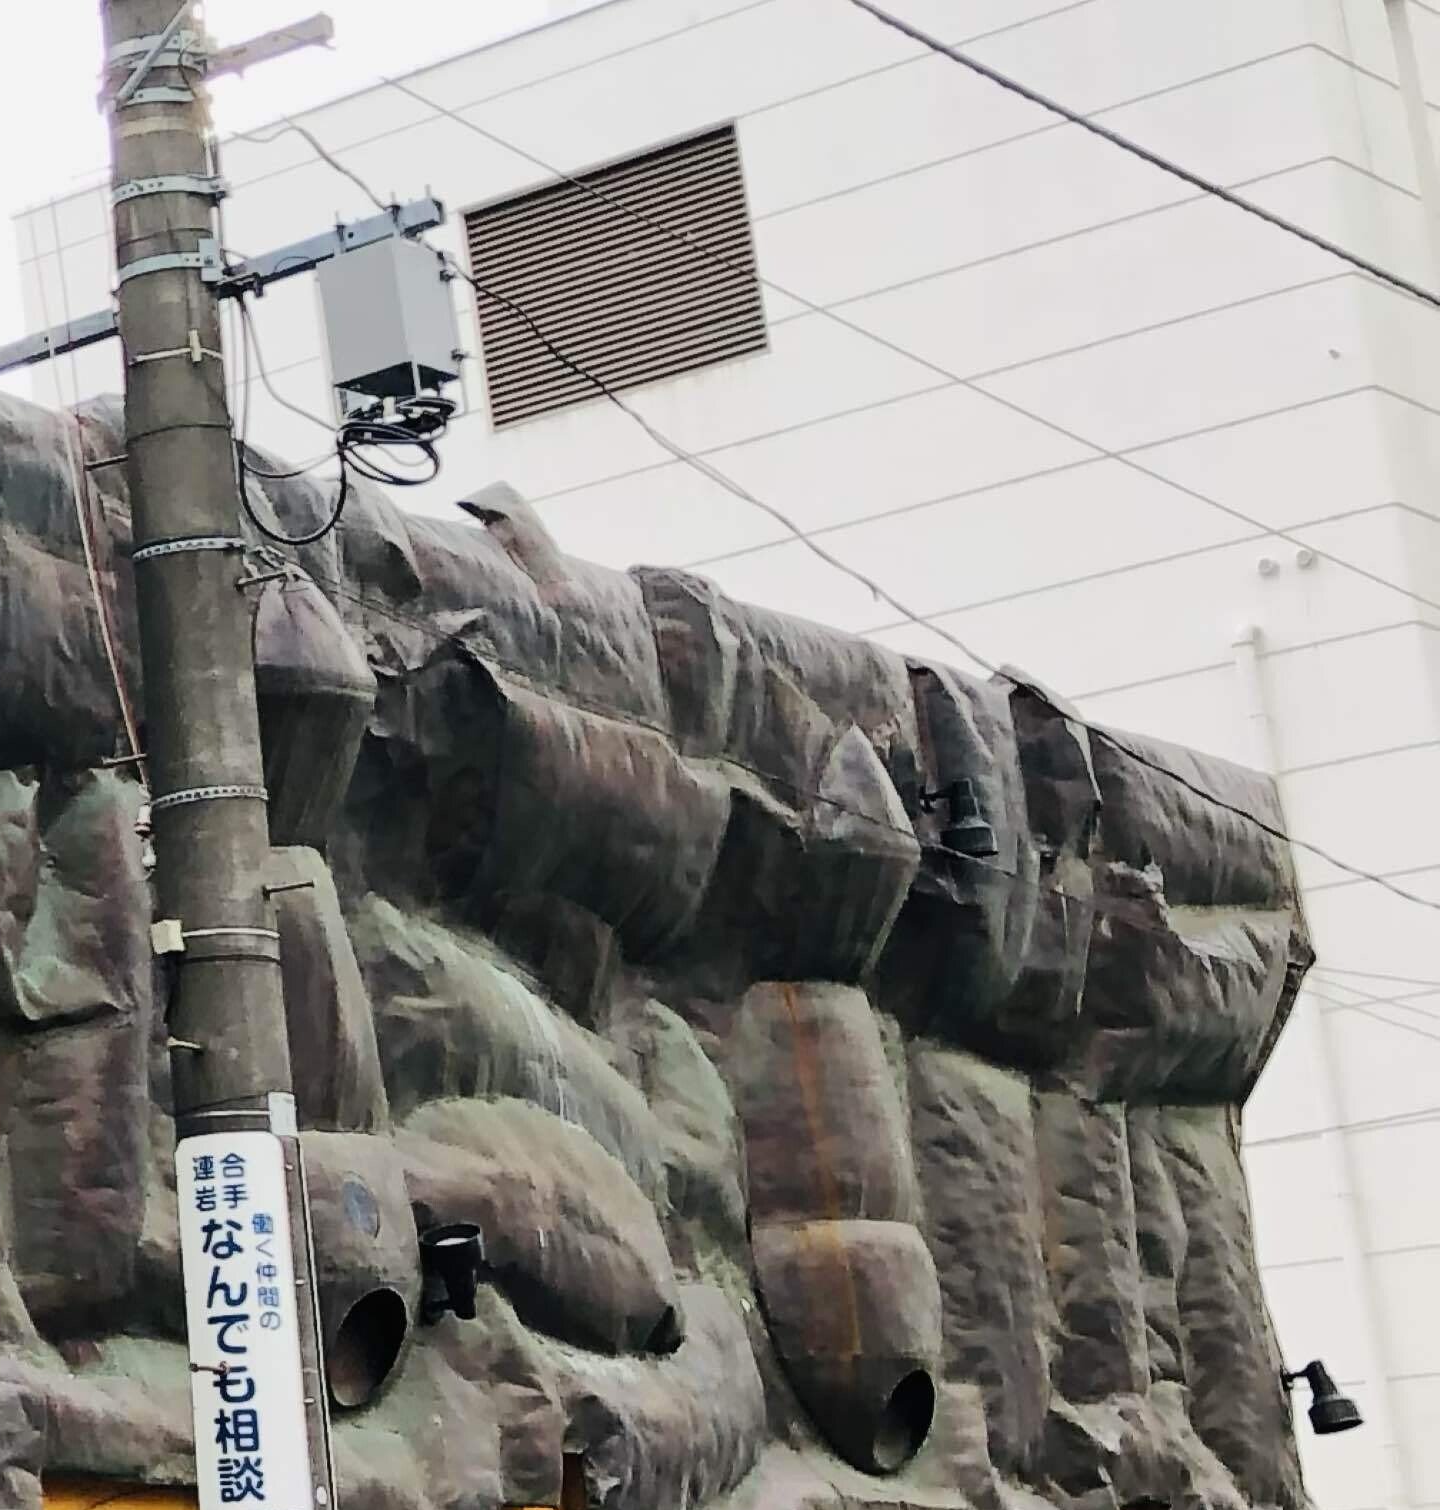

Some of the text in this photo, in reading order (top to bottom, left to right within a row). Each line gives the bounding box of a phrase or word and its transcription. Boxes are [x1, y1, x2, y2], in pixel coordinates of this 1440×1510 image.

[201, 1218, 265, 1503] なんでも相談
